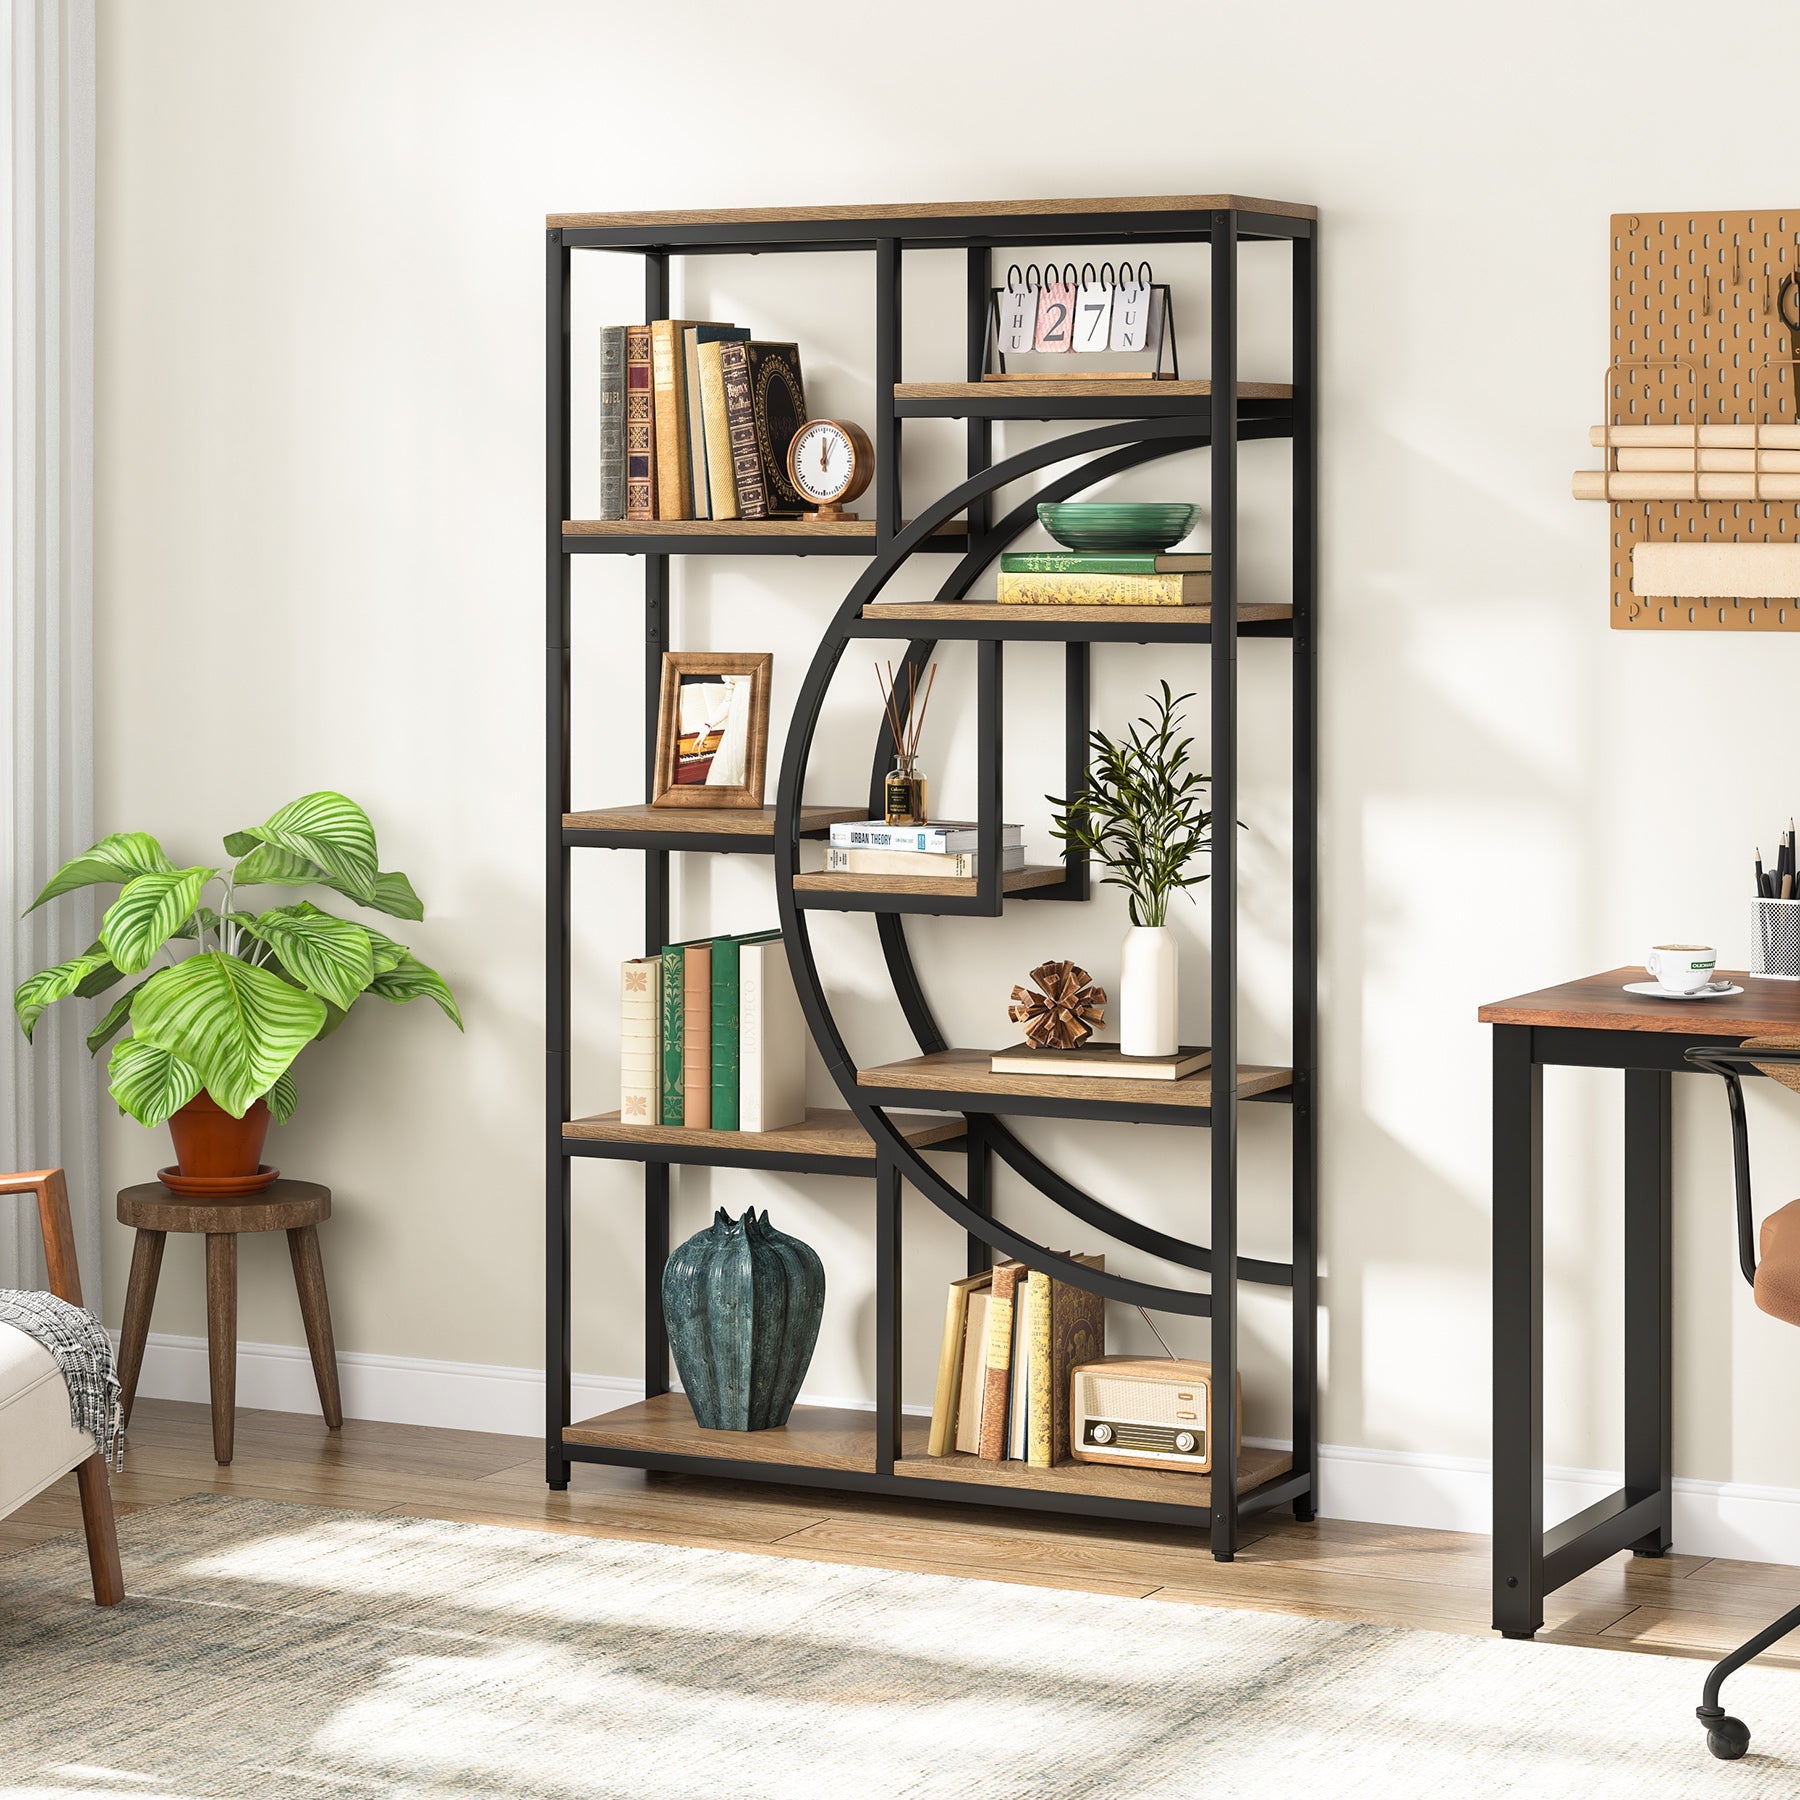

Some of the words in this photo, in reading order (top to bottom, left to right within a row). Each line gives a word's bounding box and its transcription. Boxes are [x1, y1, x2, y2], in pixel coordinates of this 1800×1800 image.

[1011, 293, 1026, 350] THU
[1122, 290, 1138, 347] JUN
[851, 832, 869, 844] URBAN
[871, 833, 892, 846] THEORY
